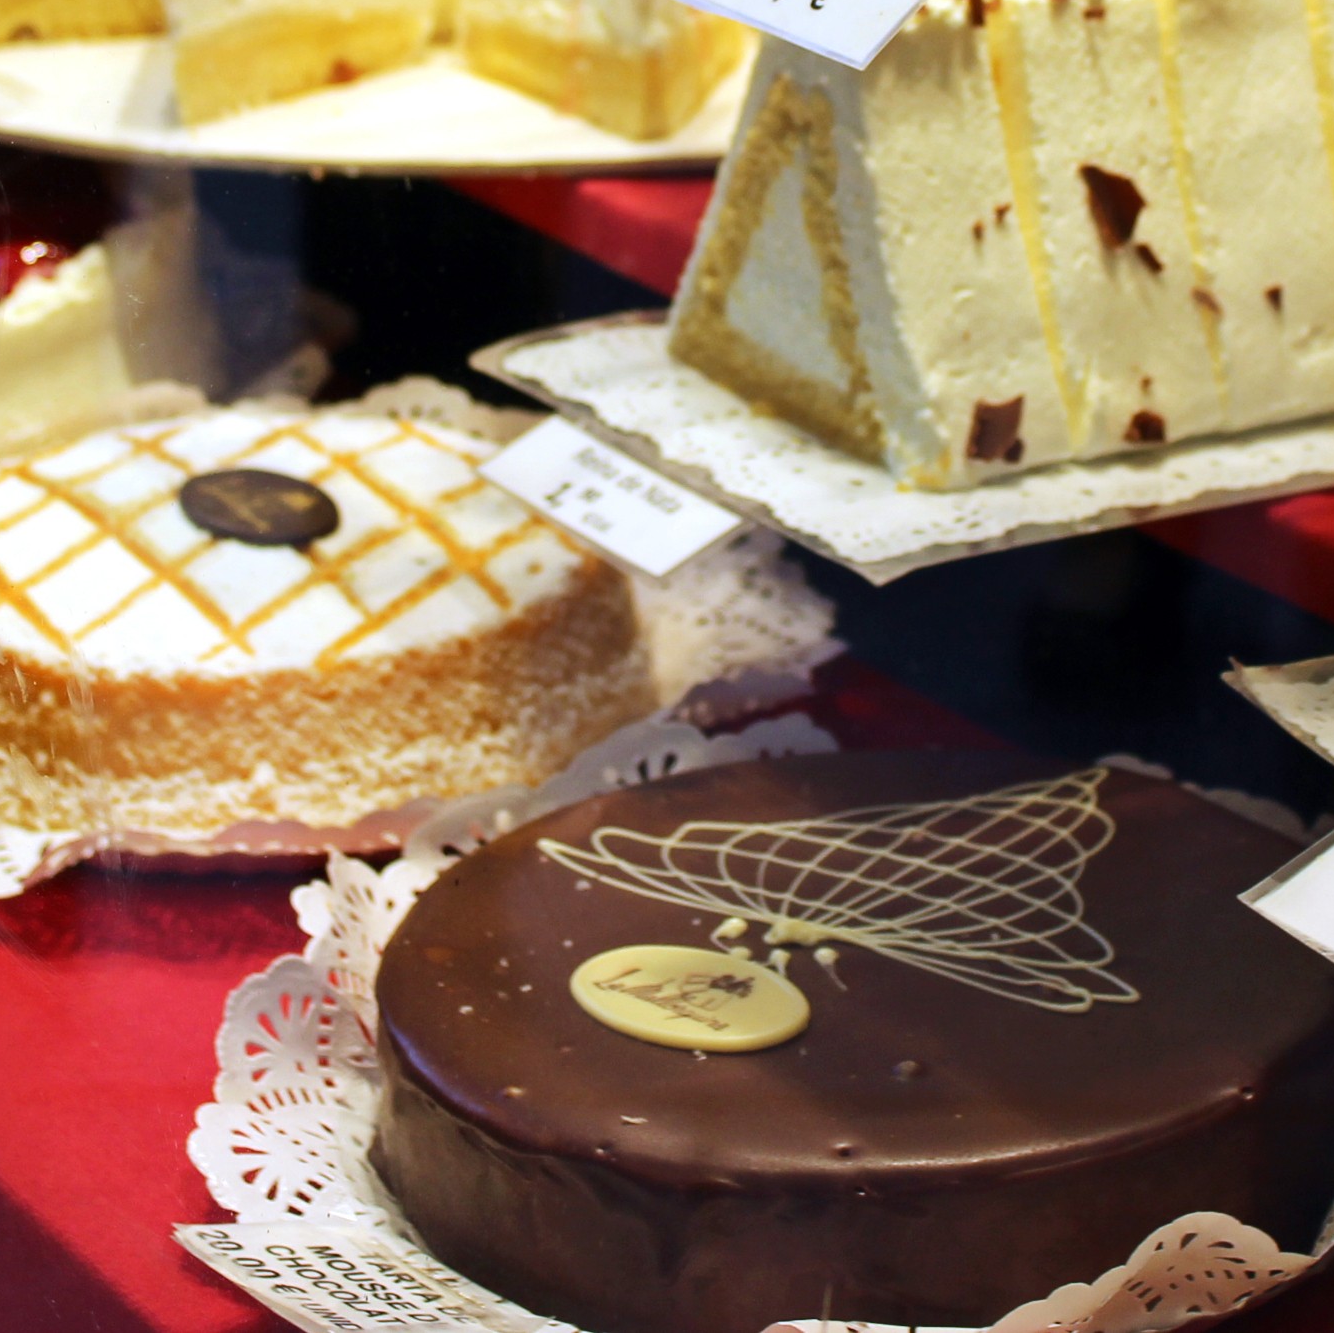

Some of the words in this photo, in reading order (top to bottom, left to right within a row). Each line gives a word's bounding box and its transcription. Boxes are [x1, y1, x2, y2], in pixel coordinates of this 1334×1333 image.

[265, 1245, 409, 1326] CHOCOLAT
[307, 1245, 419, 1310] MOUSSE
[358, 1252, 443, 1303] TARTA
